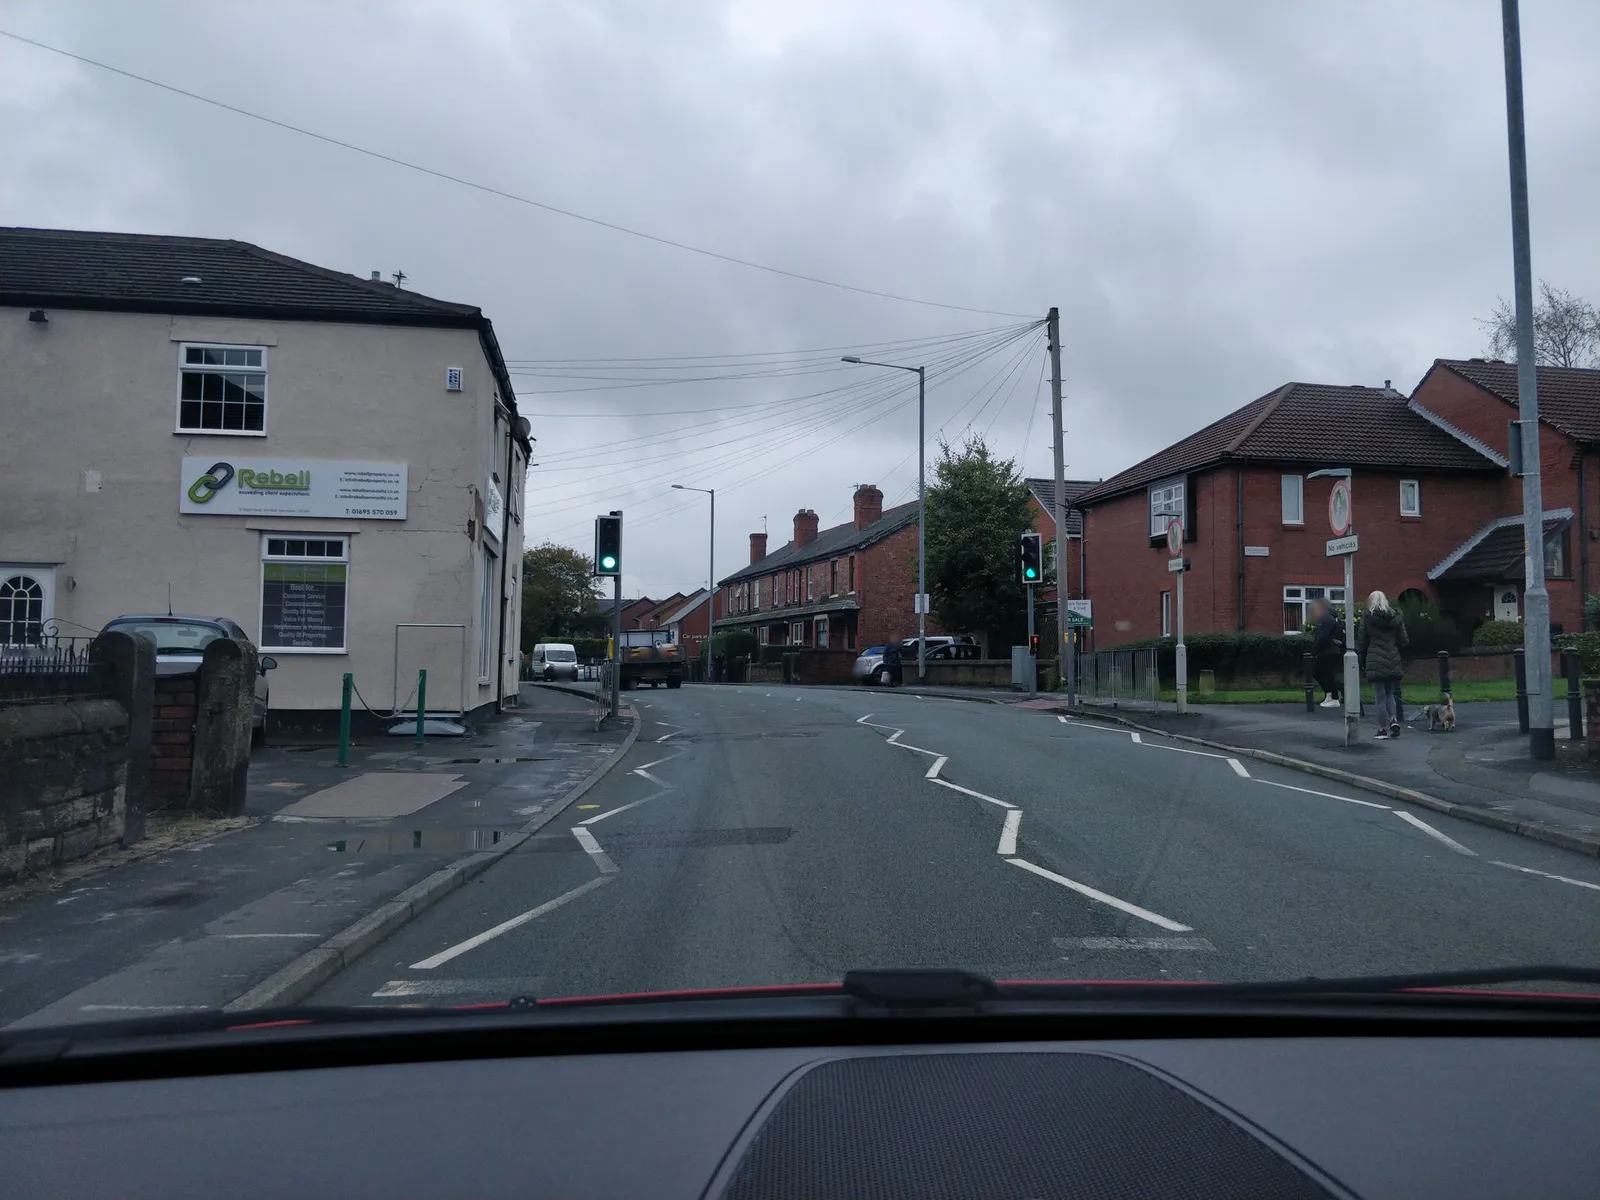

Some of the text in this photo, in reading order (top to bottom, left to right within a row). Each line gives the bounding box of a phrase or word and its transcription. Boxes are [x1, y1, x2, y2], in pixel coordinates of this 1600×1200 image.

[238, 468, 310, 490] Rebell
[1328, 541, 1356, 552] No vehicles
[290, 583, 304, 591] Best
[282, 608, 299, 616] Quality
[306, 608, 324, 616] Repairs
[292, 639, 313, 647] Security
